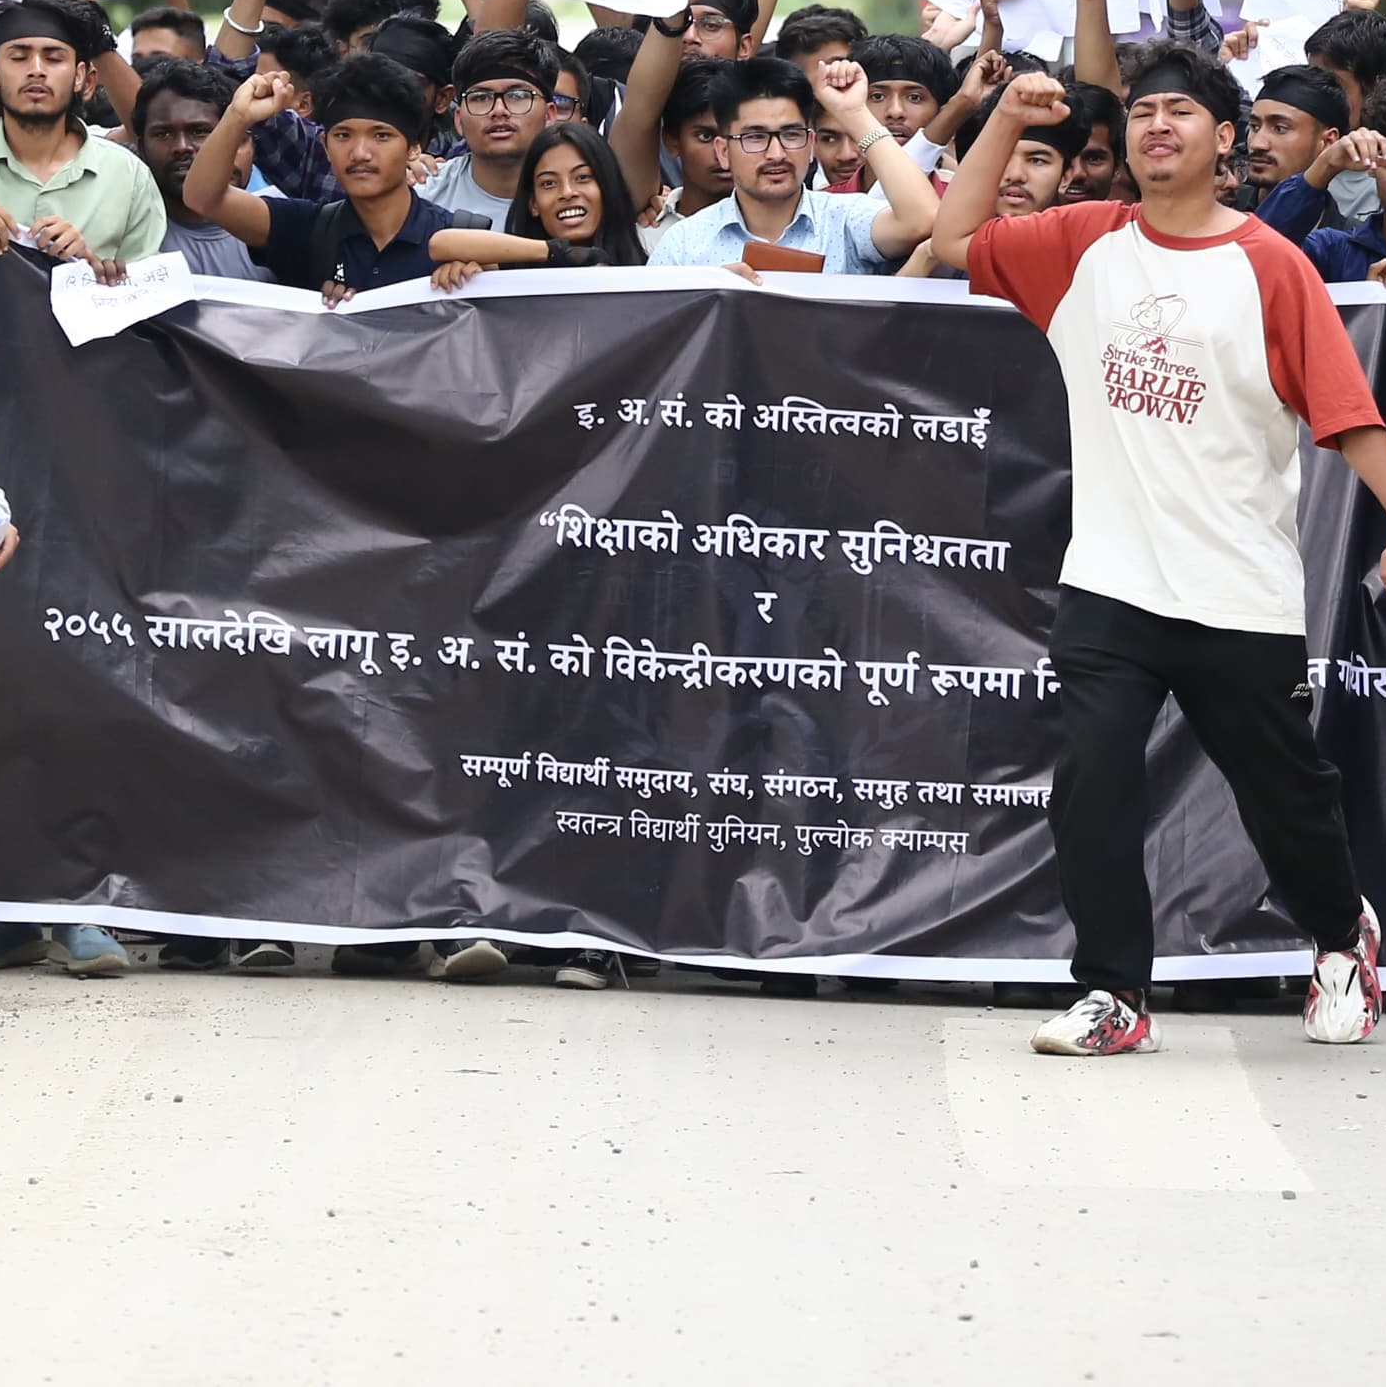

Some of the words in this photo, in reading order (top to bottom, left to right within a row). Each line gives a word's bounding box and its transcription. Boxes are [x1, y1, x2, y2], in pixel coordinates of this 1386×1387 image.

[1103, 344, 1147, 367] Strike
[1150, 357, 1199, 379] Three,
[573, 403, 605, 430] इ.
[617, 399, 650, 426] अ.
[659, 392, 693, 428] सं.
[703, 393, 746, 430] को
[753, 396, 904, 439] अस्तित्वको
[539, 503, 684, 556] “शिक्षाको
[692, 513, 831, 561] अधिकार
[753, 592, 778, 624] र
[44, 607, 135, 647] २०५५
[144, 608, 298, 656] सालदेखि
[301, 626, 382, 675] लागू
[386, 632, 422, 671] इ.
[437, 636, 480, 669] अ.
[493, 631, 536, 673] सं.
[547, 634, 595, 677] को
[601, 636, 848, 691] विकेन्द्रीकरणको
[854, 651, 921, 706] पूर्ण
[927, 664, 1026, 700] रूपमा
[460, 751, 532, 788] सम्पूर्ण
[535, 752, 611, 787] विद्यार्थी
[614, 766, 698, 799] समुदाय,
[706, 767, 754, 800] संघ,
[762, 768, 843, 804] संगठन,
[851, 778, 911, 810] समुह
[915, 781, 965, 804] तथा
[555, 811, 624, 837] स्वतन्त्र
[628, 809, 702, 843] विद्यार्थी
[705, 815, 786, 852] युनियन,
[794, 819, 875, 856] पुल्चोक
[879, 828, 970, 854] क्याम्पस
